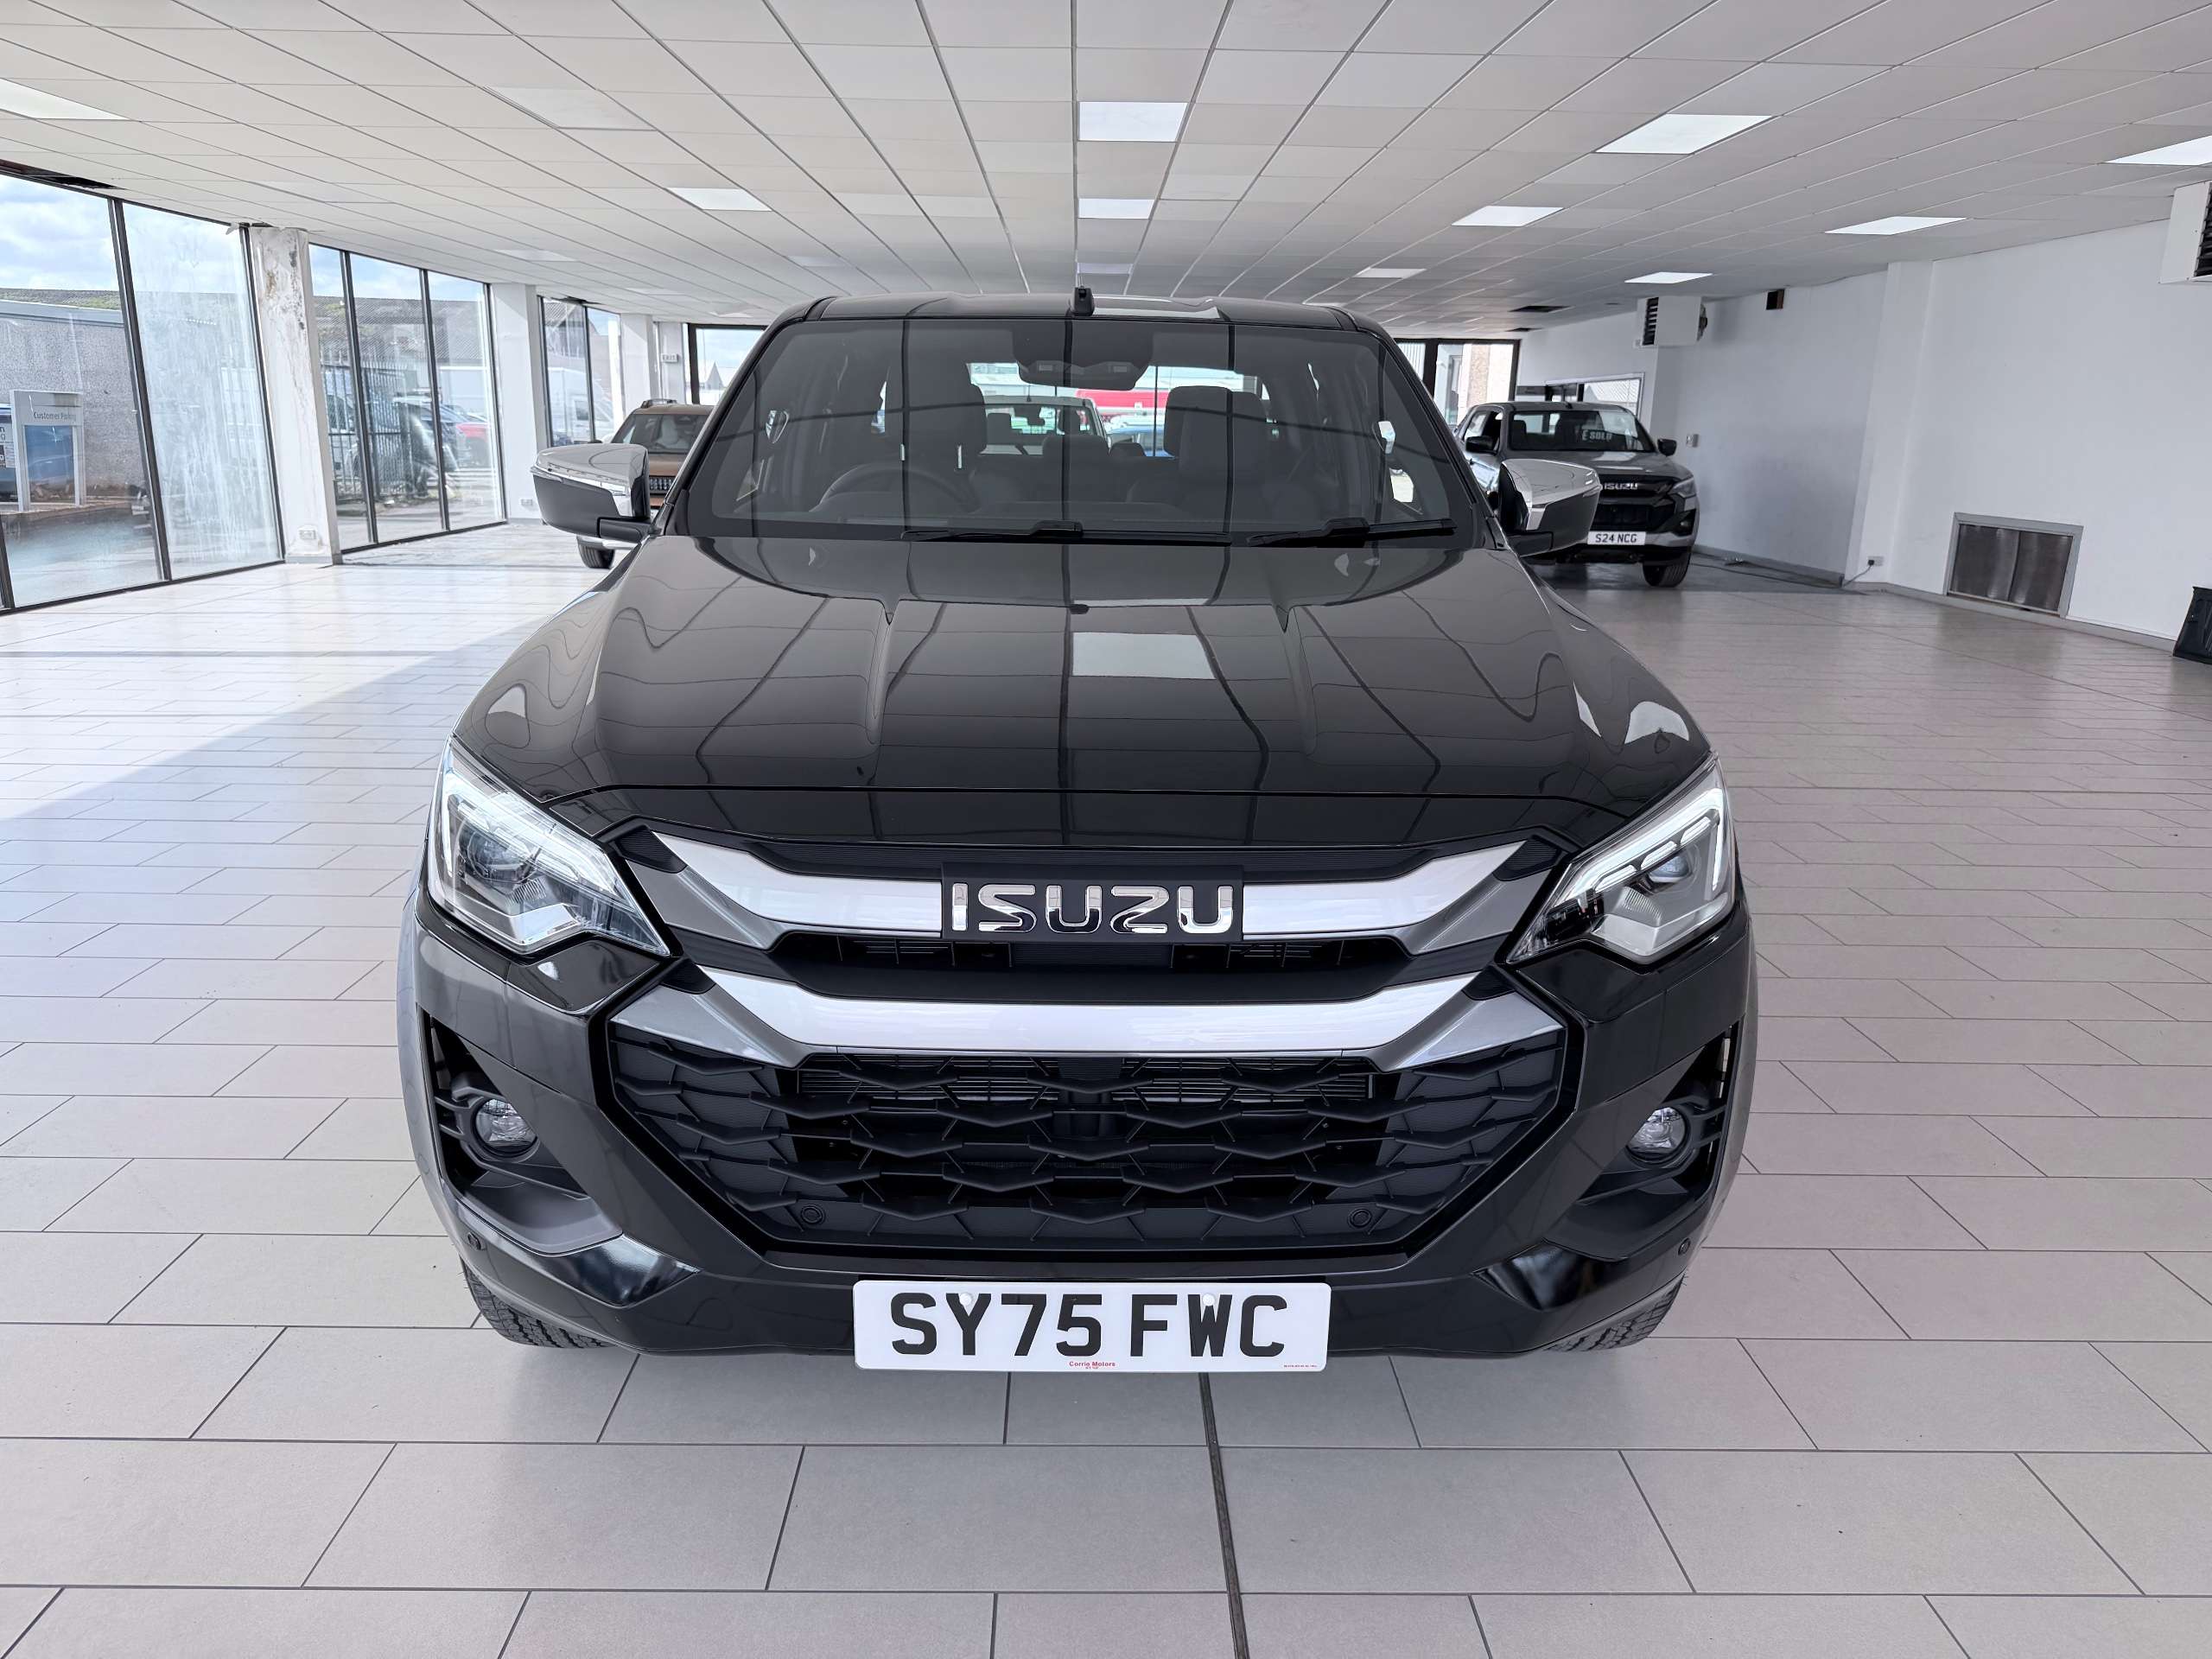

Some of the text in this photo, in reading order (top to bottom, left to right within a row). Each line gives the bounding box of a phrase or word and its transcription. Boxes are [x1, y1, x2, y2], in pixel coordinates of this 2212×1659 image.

[33, 411, 60, 420] Customer
[1595, 533, 1637, 543] S24 NCG
[952, 882, 1234, 934] ISUZU
[890, 1292, 1287, 1357] SY75 FWC
